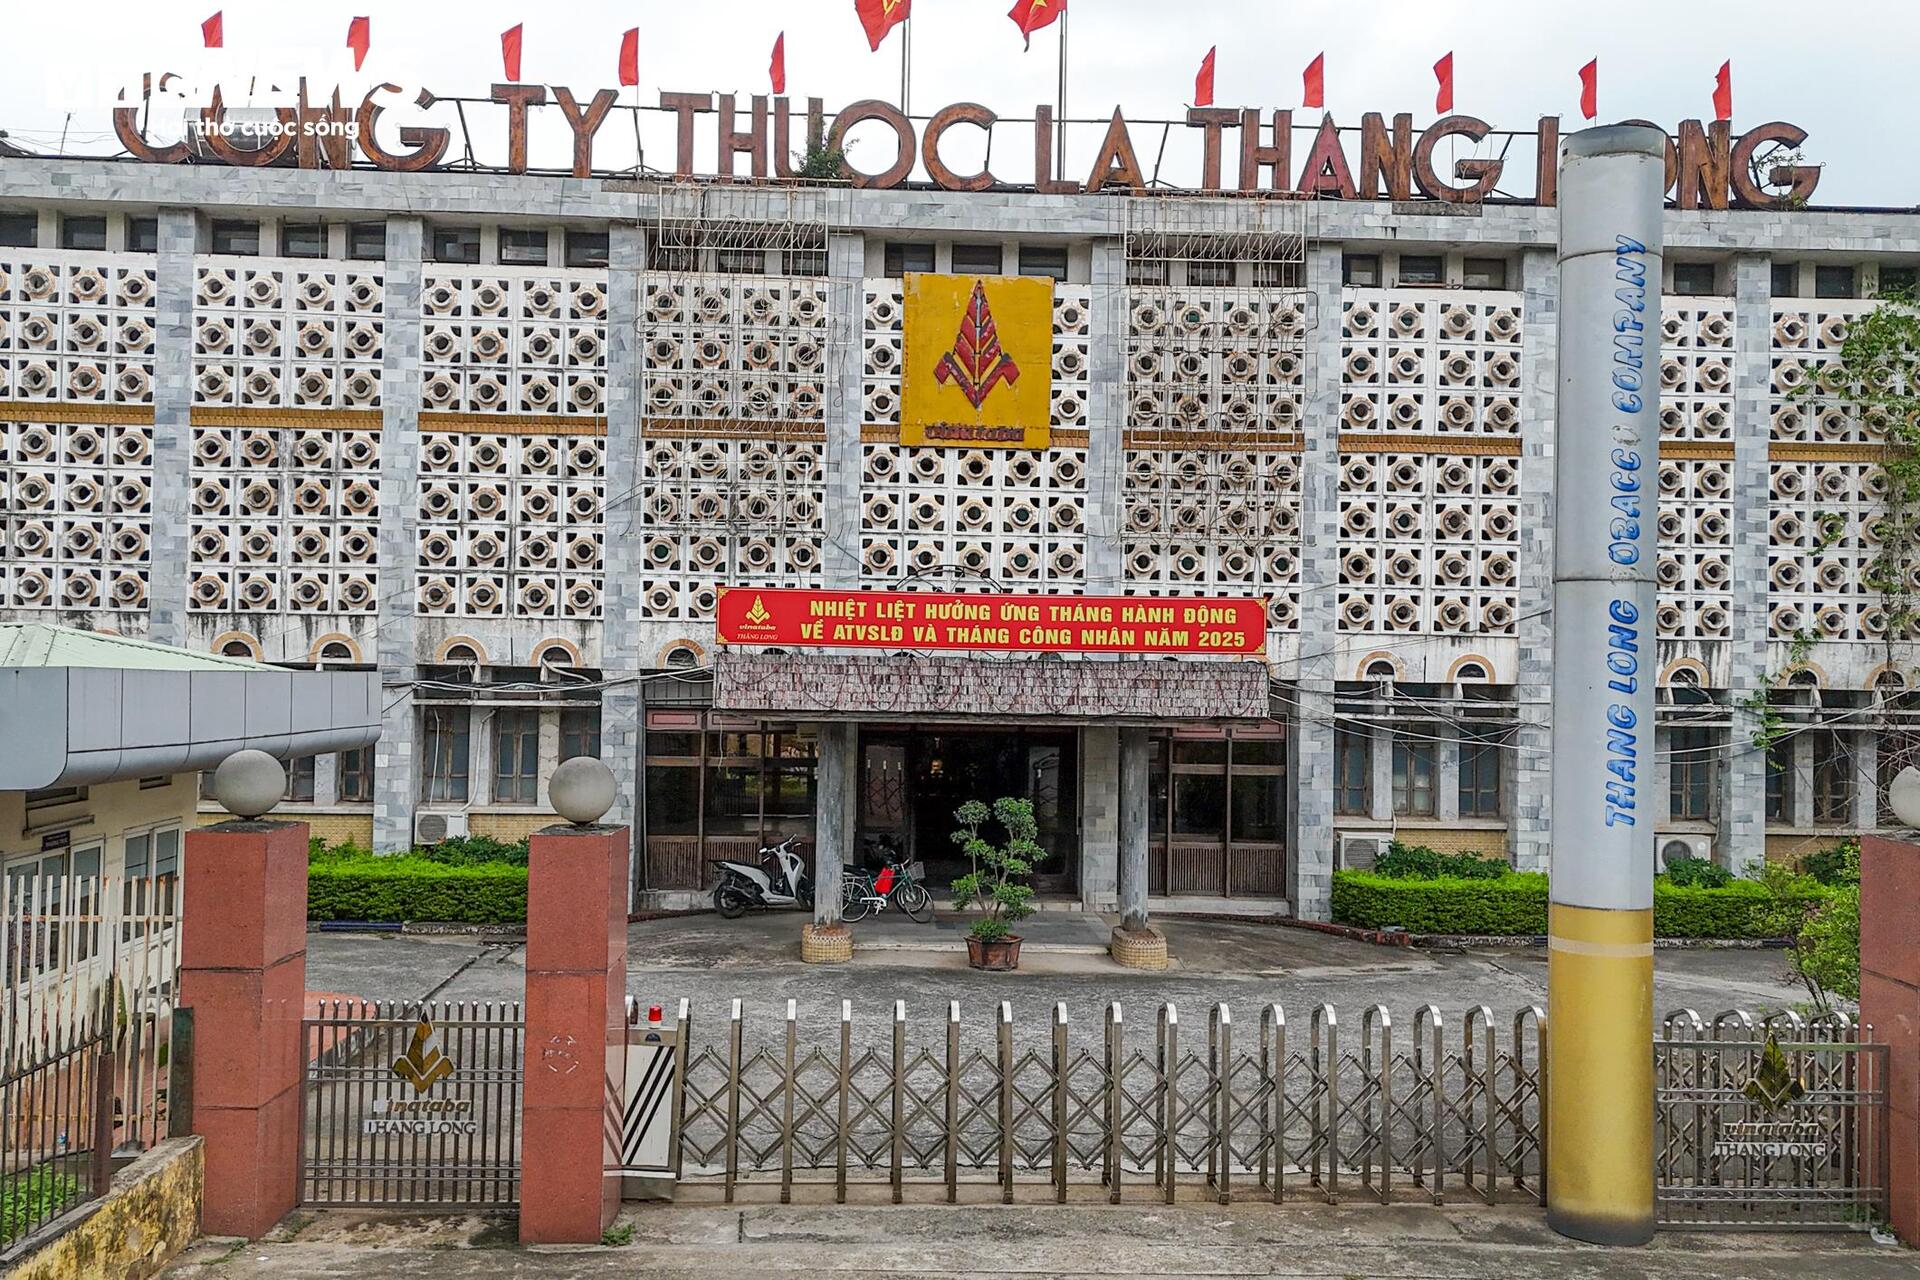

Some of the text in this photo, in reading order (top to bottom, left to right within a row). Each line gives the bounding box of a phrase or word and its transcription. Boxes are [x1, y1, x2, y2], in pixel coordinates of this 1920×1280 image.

[491, 83, 619, 178] TY
[659, 90, 998, 191] THUOC
[1035, 105, 1145, 197] LA
[1186, 105, 1505, 202] THANG
[1538, 116, 1821, 210] LNG
[1611, 234, 1646, 413] COMPANY
[800, 618, 1245, 647] VỀ ATVSLĐ VÀ THÁNG CÔNG NHÂN NĂM 2025
[810, 598, 1237, 627] NHIỆT LIỆT HƯỞNG ỨNG THÁNG HÀNH ĐỘNG
[1607, 599, 1639, 694] LONG
[1605, 703, 1637, 827] THANG
[373, 1098, 471, 1112] inataba
[430, 1121, 476, 1134] LONG
